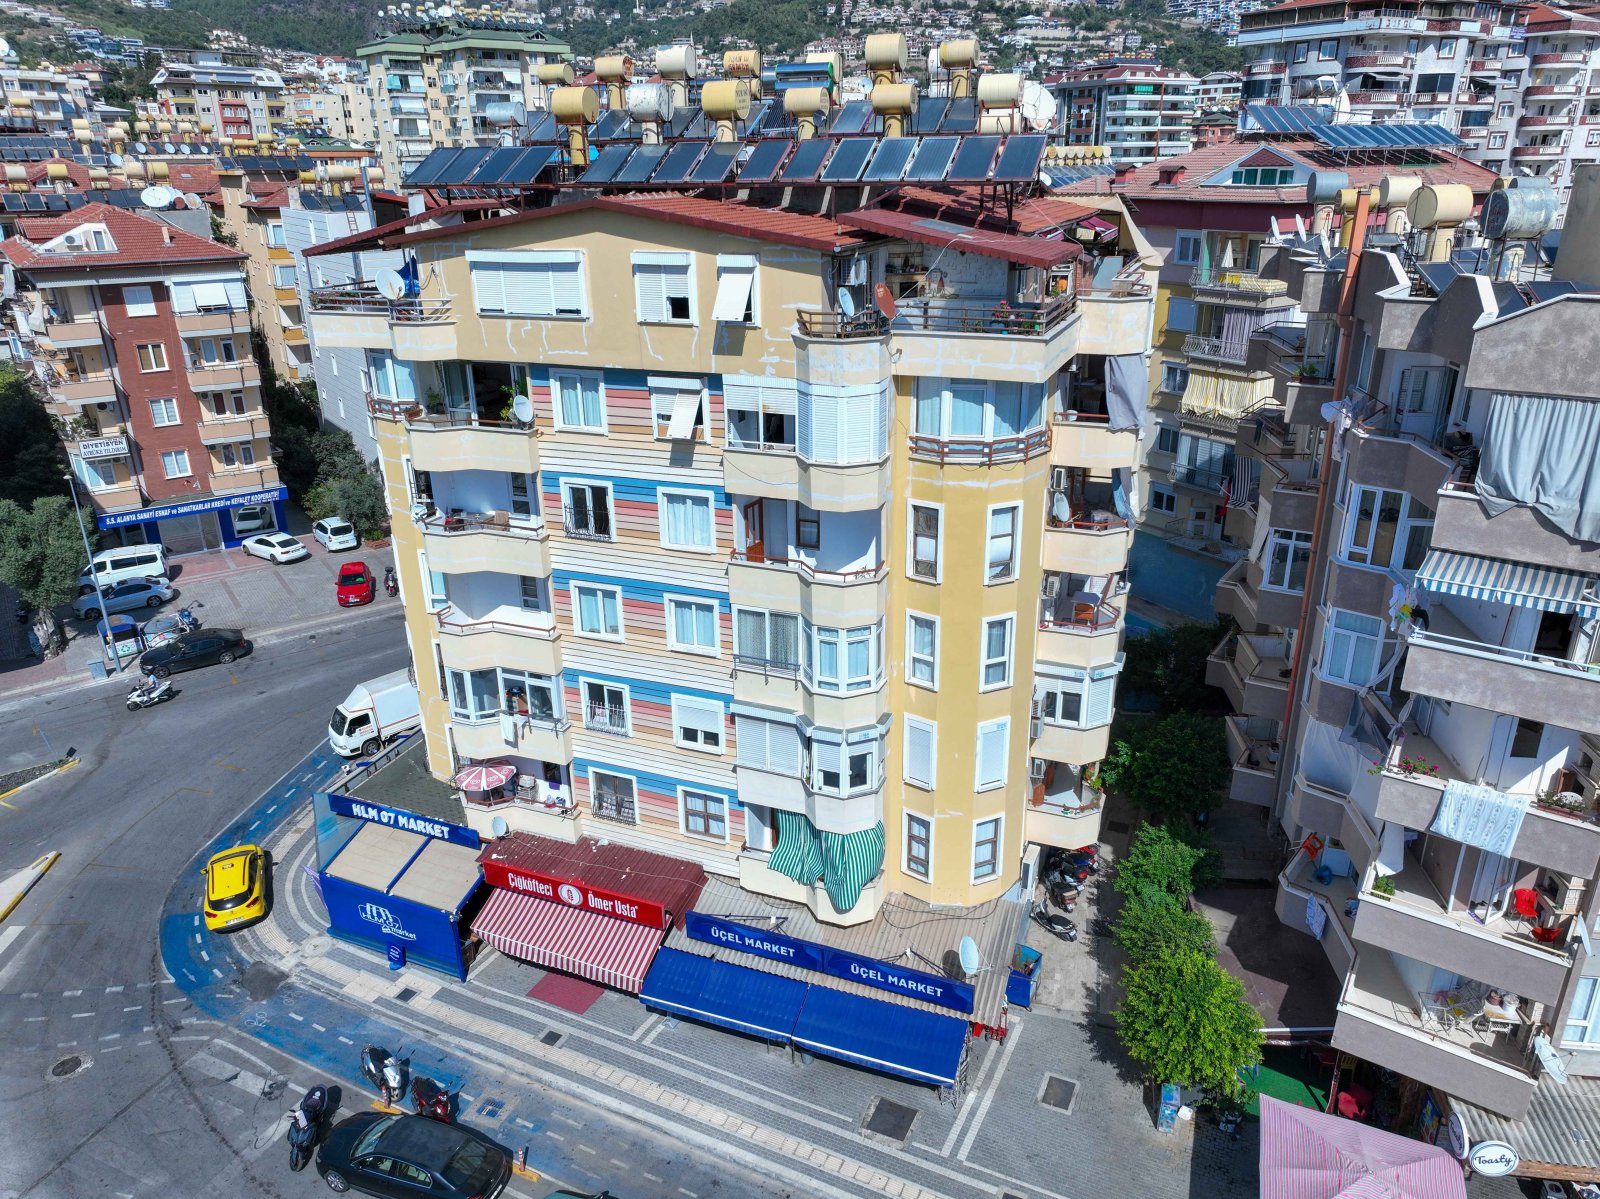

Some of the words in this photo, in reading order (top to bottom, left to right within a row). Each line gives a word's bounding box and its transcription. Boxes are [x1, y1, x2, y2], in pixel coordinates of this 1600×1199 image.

[116, 514, 137, 524] ALANYA
[155, 508, 171, 518] ESNAF
[352, 803, 379, 821] HLM
[380, 811, 396, 825] 07
[397, 815, 450, 839] MARKET
[508, 872, 553, 897] Çiğköfteci
[588, 890, 614, 911] Ömer
[711, 926, 743, 945] ÜÇEL
[744, 936, 796, 957] MARKET
[850, 963, 885, 982] ÜÇEL
[887, 975, 944, 997] MARKET
[1474, 1154, 1513, 1167] Toasty
